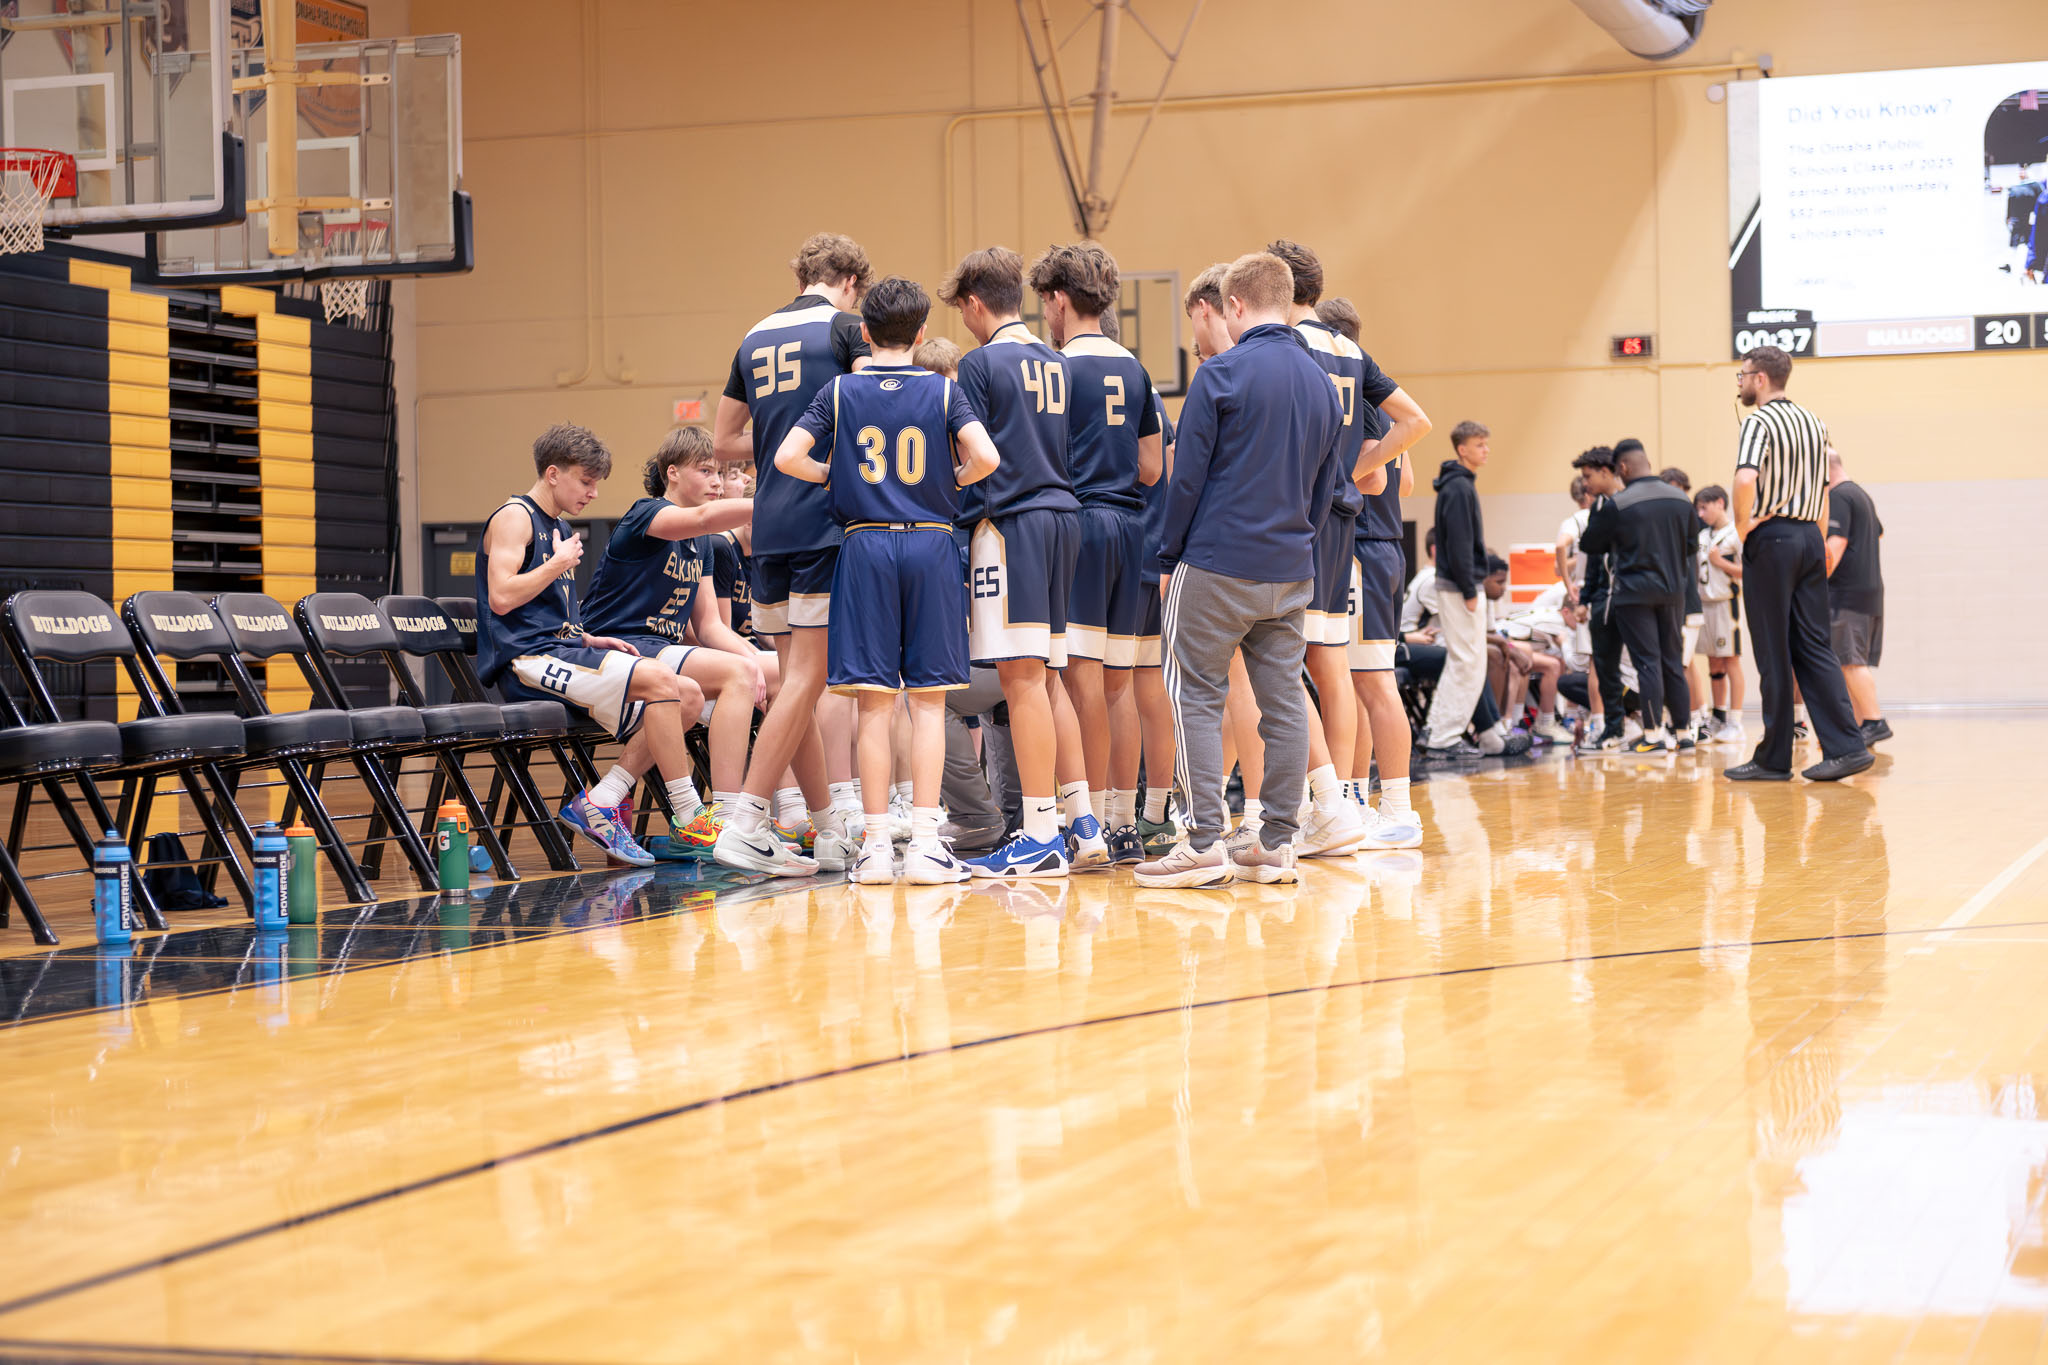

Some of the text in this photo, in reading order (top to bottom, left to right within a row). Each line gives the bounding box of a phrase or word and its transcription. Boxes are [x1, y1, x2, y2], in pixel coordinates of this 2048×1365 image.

[1788, 97, 1953, 125] Did You Know?
[1867, 325, 1966, 347] BULLDOGS
[1985, 320, 2022, 345] 20
[752, 341, 802, 400] 35
[1020, 359, 1066, 415] 40
[1104, 376, 1126, 426] 2
[1328, 372, 1355, 426] 0
[857, 426, 926, 486] 30
[975, 566, 1000, 599] ES
[30, 615, 113, 634] BULLDOGS
[150, 614, 214, 633] BULLDOGS
[232, 614, 289, 632] BULLDOGS
[320, 614, 381, 632] BULLDOGS
[391, 616, 447, 632] BULLDOGS
[541, 664, 572, 695] ES
[121, 864, 131, 930] POWERADE
[280, 854, 289, 917] POWERADE
